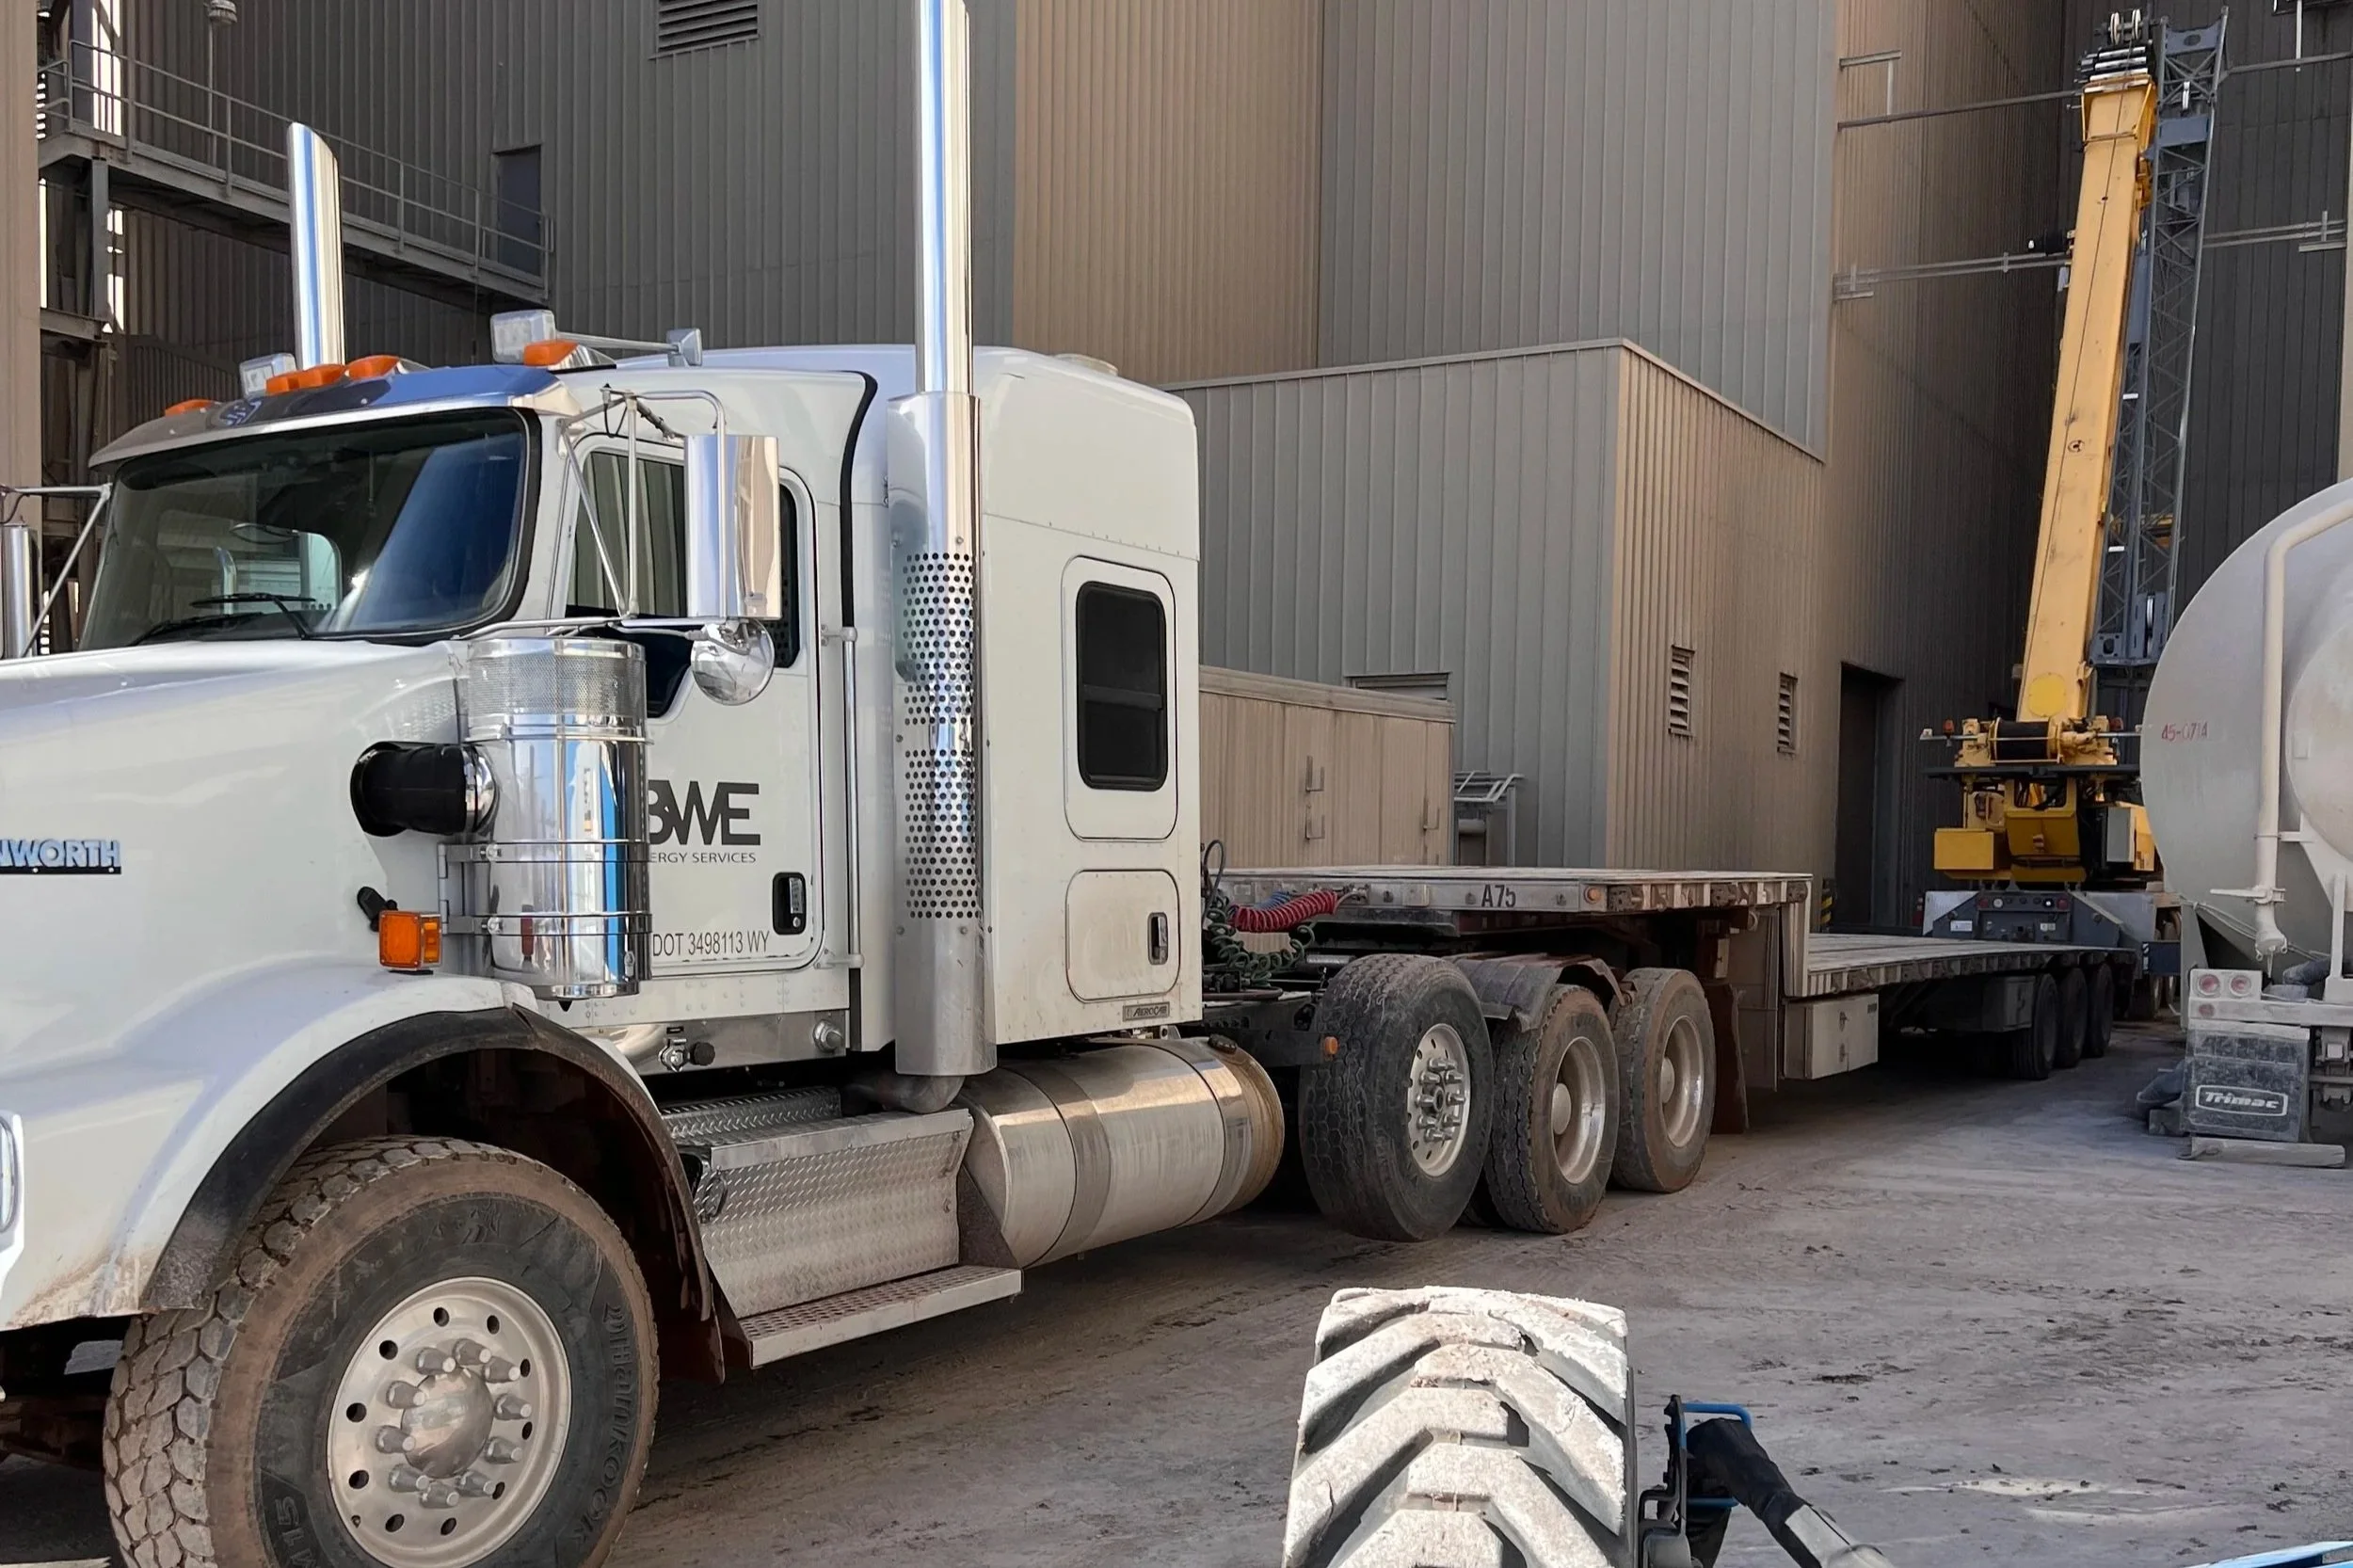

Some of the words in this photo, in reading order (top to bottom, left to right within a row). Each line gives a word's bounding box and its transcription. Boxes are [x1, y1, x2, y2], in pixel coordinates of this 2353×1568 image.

[648, 779, 761, 846] BWE
[692, 852, 757, 863] SERVICES
[1481, 884, 1516, 908] A75
[652, 933, 684, 956] DOT
[688, 931, 744, 955] 3498113
[746, 930, 770, 952] WY
[2205, 1092, 2280, 1109] Trimac
